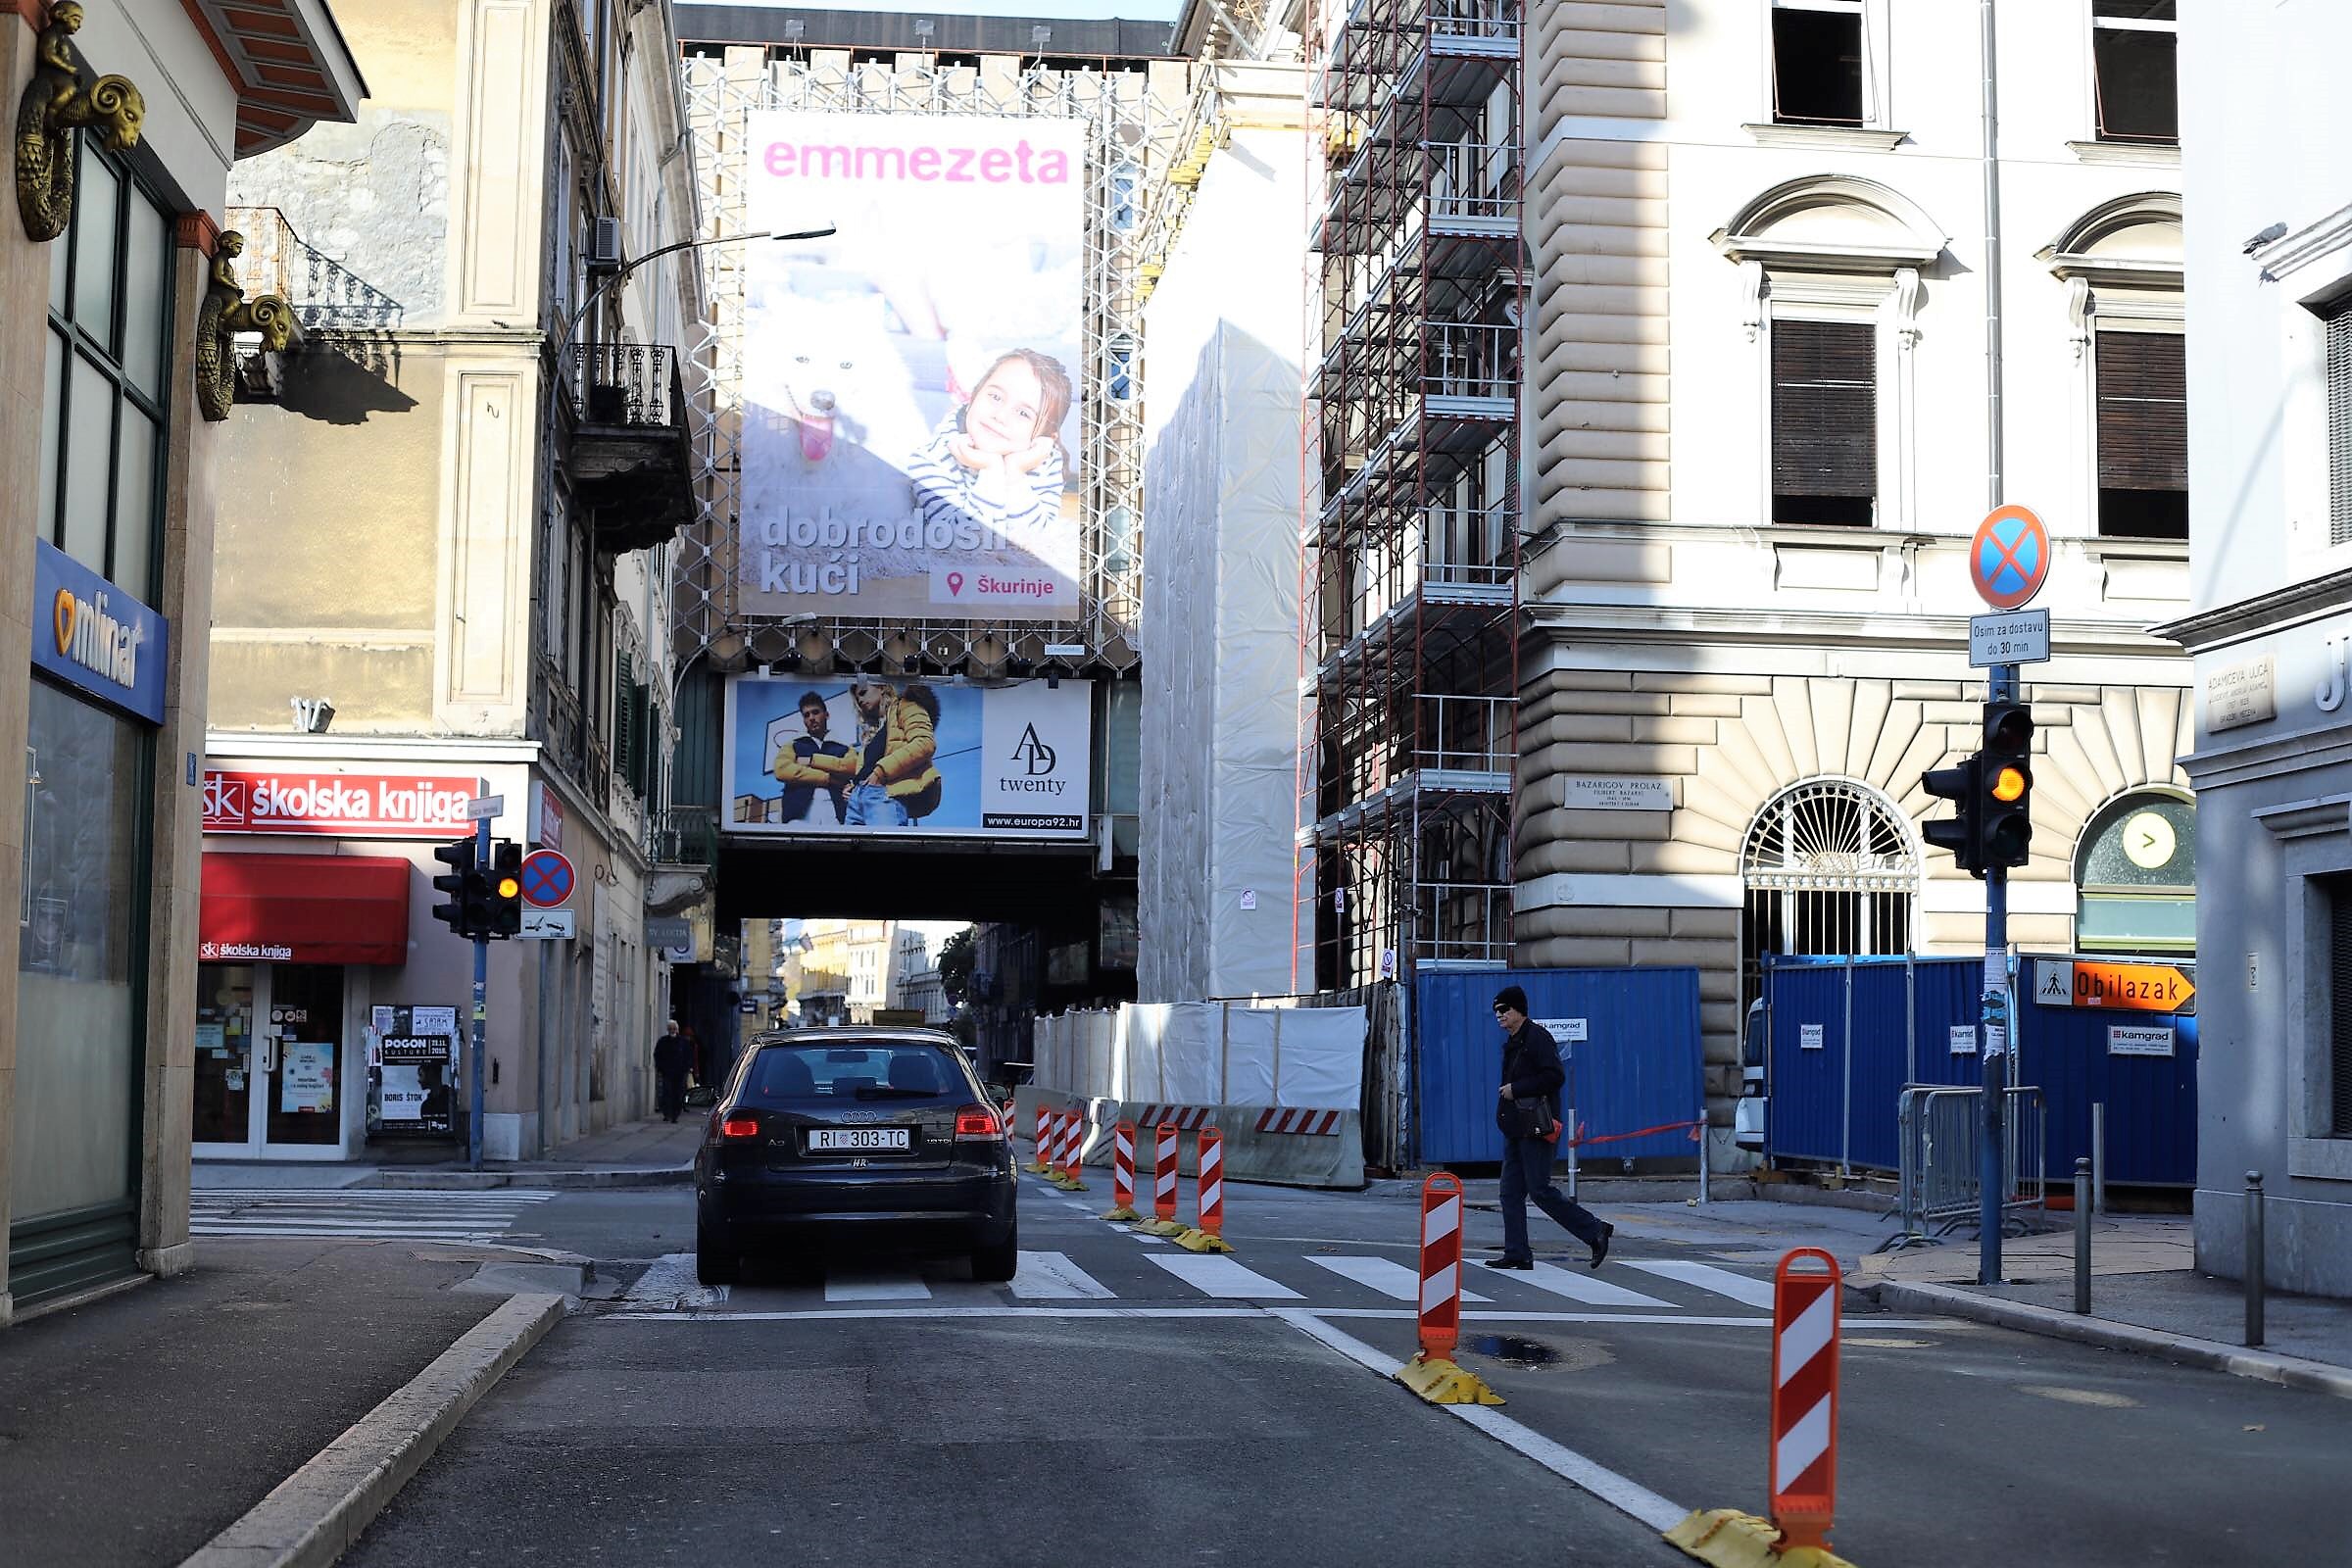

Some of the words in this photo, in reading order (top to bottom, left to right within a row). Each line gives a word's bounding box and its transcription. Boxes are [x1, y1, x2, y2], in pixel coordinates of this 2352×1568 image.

[763, 139, 1068, 183] emmezeta
[760, 506, 1007, 551] dobrodošli
[760, 551, 860, 594] kući
[978, 573, 1054, 598] Škurinje
[1974, 624, 1994, 637] Osim
[1997, 626, 2007, 635] za
[2009, 621, 2043, 635] dostavu
[72, 590, 143, 689] mlinar
[1987, 643, 1997, 655] do
[2000, 642, 2011, 654] 30
[2013, 642, 2029, 653] min
[1000, 777, 1066, 796] twenty
[251, 778, 370, 819] školska
[378, 780, 471, 823] knjiga
[987, 816, 1080, 828] www.europa92.hr
[220, 943, 260, 956] školska
[261, 944, 292, 958] knjiga
[2078, 971, 2179, 1001] Obilazak
[384, 1039, 426, 1049] POGON
[2122, 1031, 2169, 1041] kamgrad
[384, 1093, 404, 1102] BORIS
[820, 1131, 836, 1148] RI
[851, 1131, 906, 1148] 303-TC
[853, 1158, 868, 1167] HR
